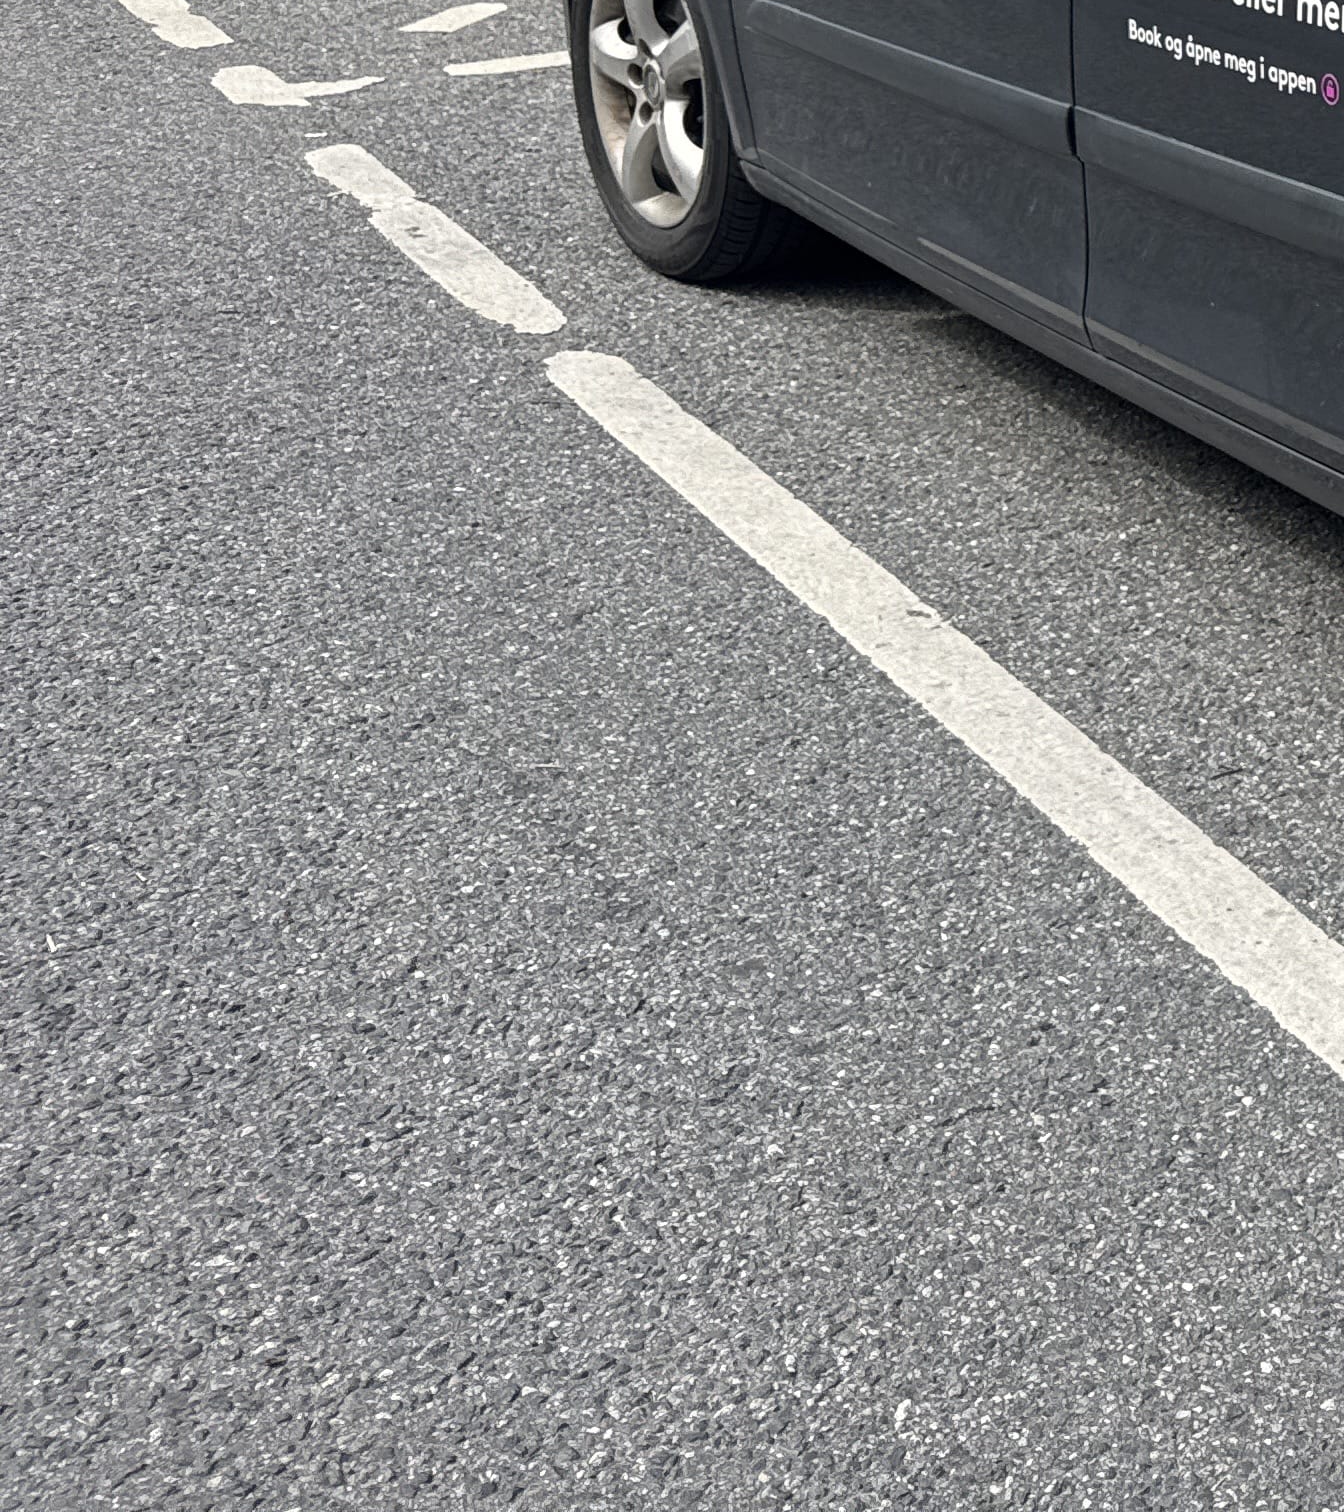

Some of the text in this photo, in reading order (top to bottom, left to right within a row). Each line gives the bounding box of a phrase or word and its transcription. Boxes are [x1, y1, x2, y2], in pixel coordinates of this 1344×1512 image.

[1128, 18, 1317, 96] Book og åpne meg i appen
